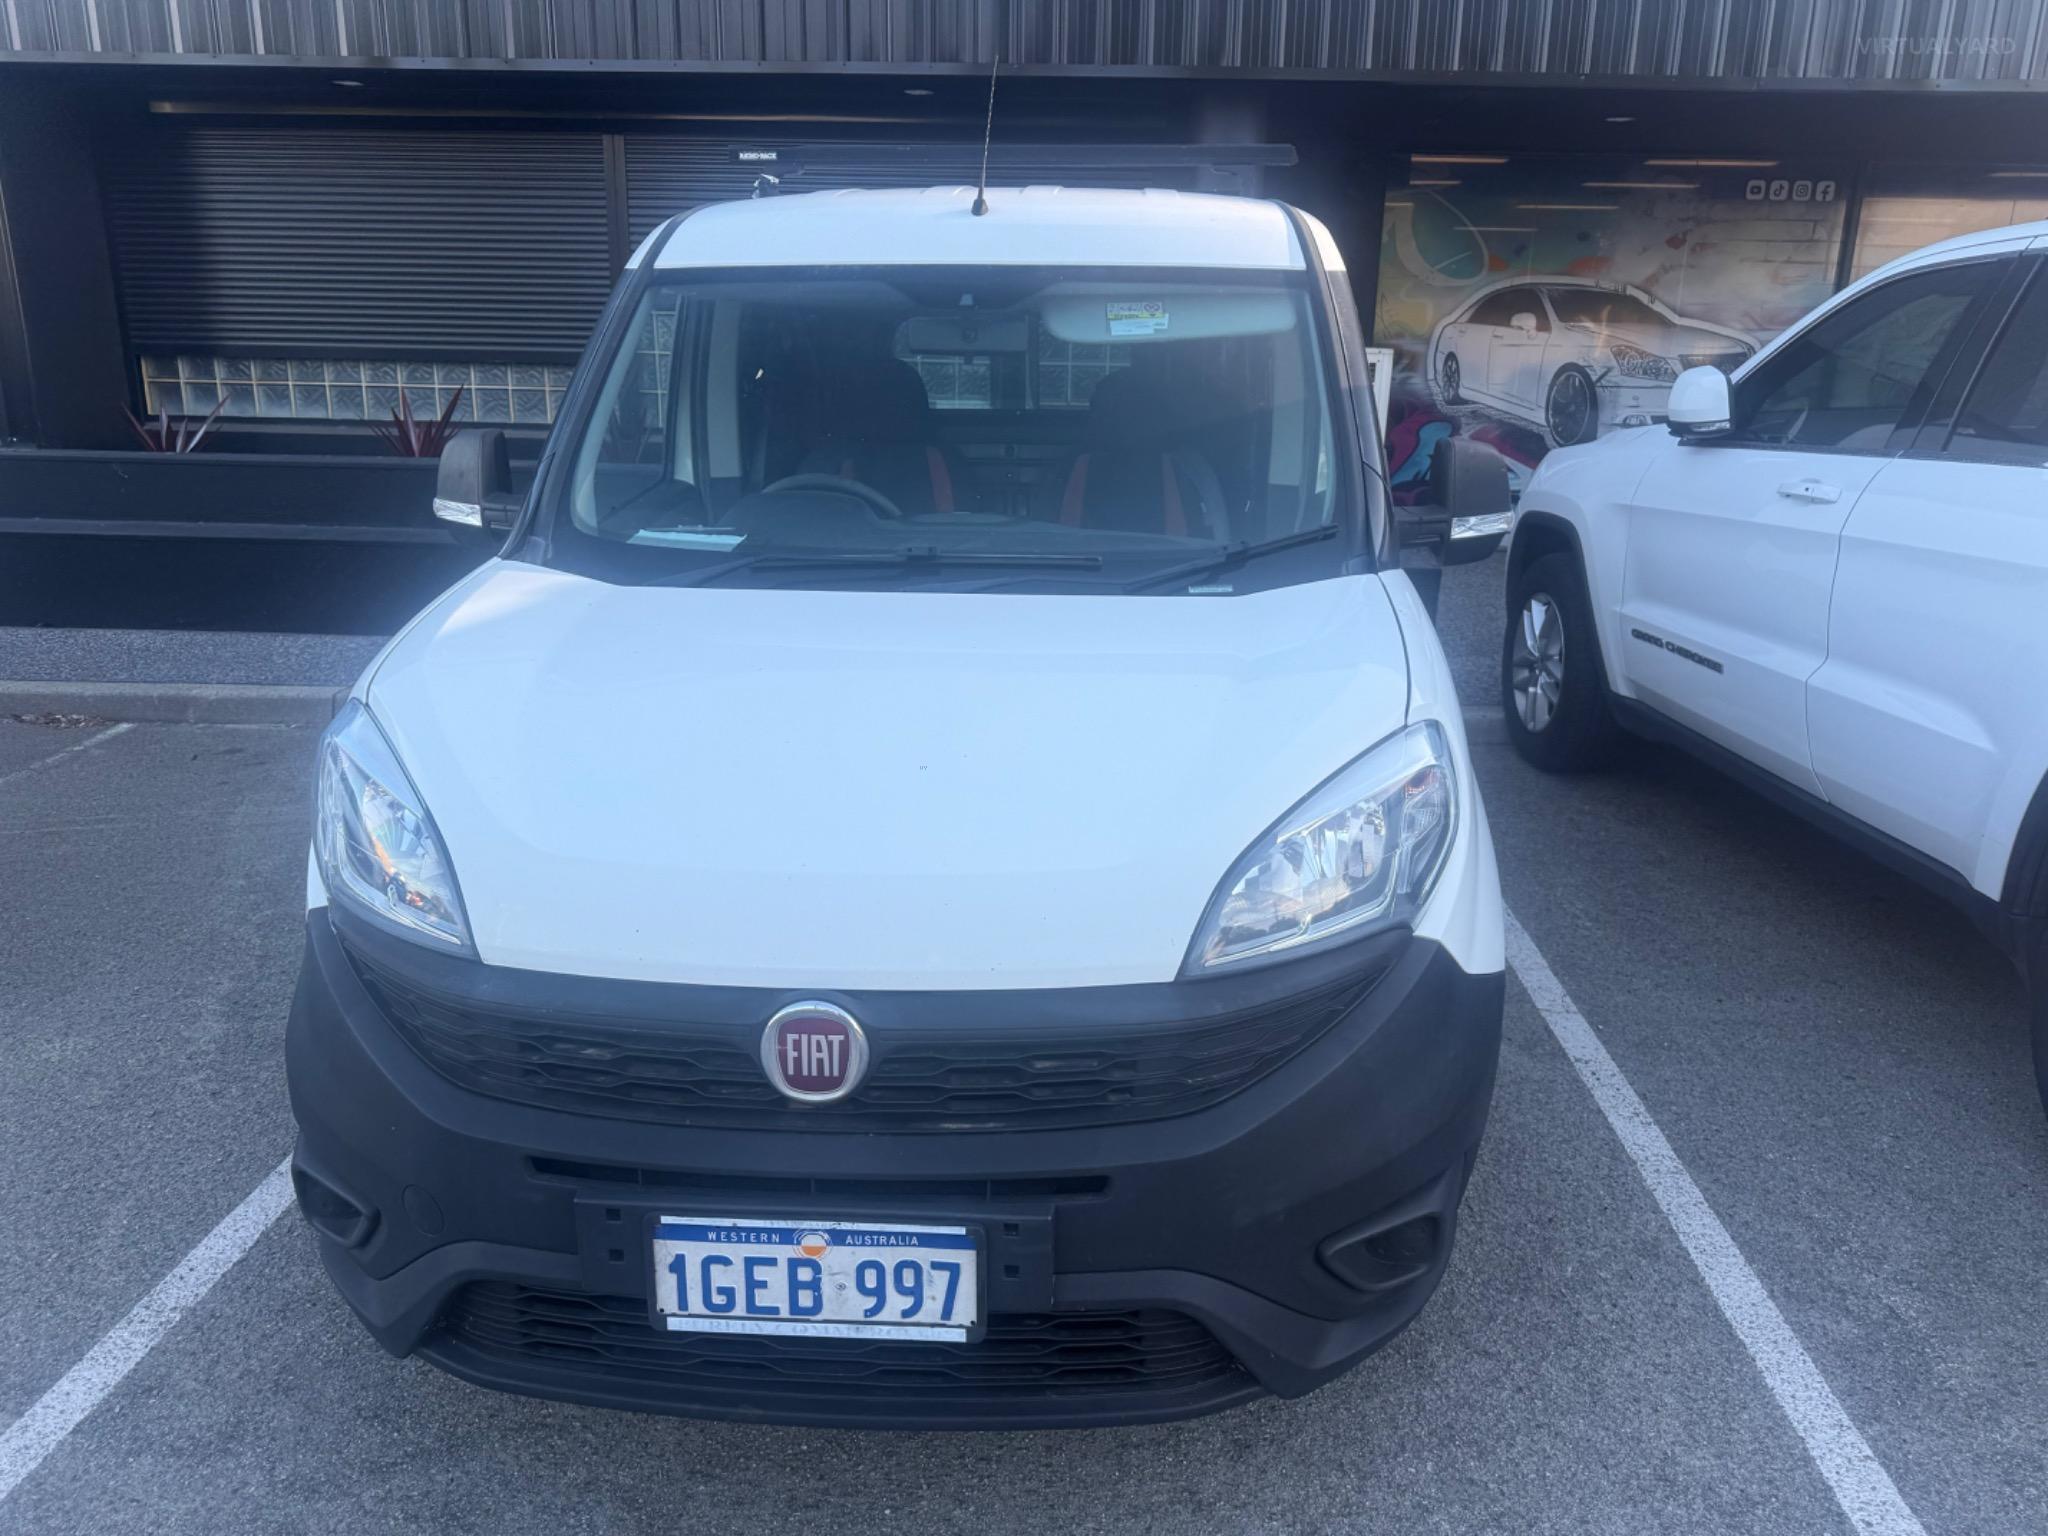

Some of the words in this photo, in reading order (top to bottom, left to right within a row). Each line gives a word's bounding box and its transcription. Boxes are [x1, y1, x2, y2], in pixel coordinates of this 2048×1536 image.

[786, 1033, 845, 1077] FIAT
[707, 1231, 780, 1243] WESTERN
[845, 1234, 919, 1246] AUSTRALIA
[668, 1253, 824, 1317] 1GEB
[855, 1258, 961, 1322] 997
